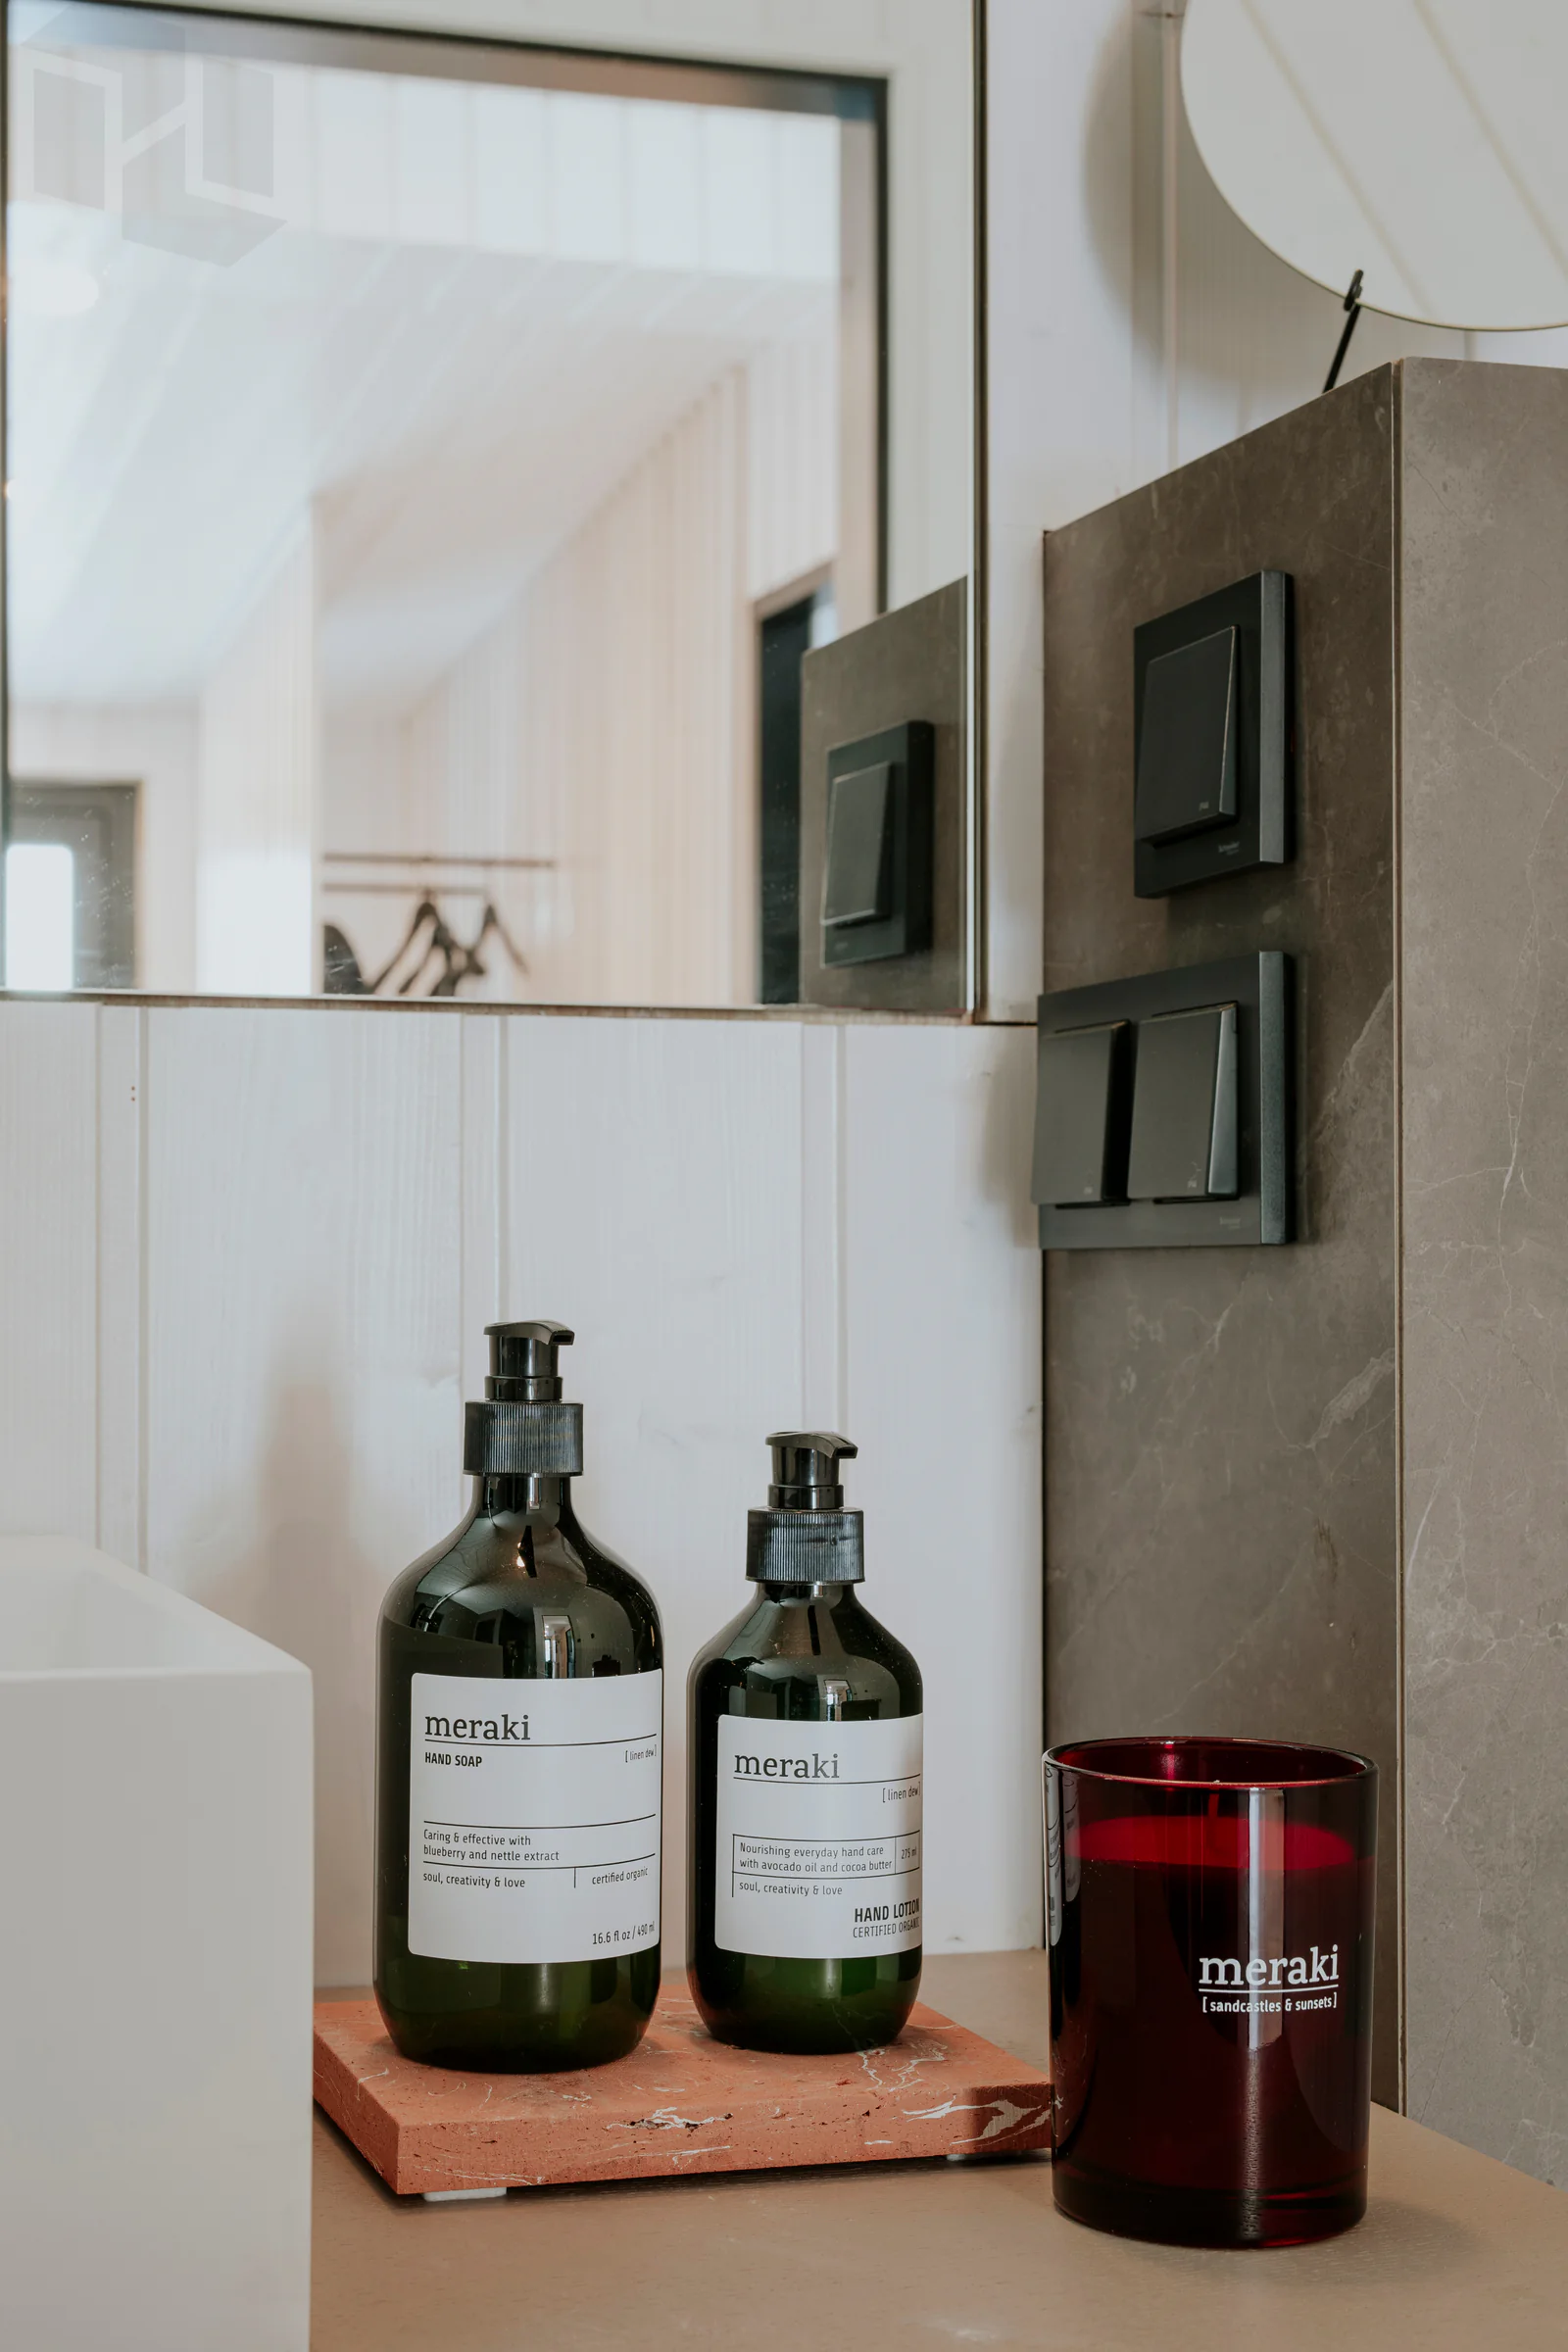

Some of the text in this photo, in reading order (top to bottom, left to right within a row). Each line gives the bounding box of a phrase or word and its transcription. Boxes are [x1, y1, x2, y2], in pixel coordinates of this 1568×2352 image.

[425, 1714, 531, 1740] meraki
[424, 1752, 482, 1767] HAND SOAP
[734, 1753, 840, 1779] meraki
[887, 1788, 906, 1801] linen
[423, 1829, 531, 1845] Caring & effective with
[423, 1844, 560, 1861] blueberry and nettle extract
[740, 1842, 884, 1859] Nourishing everyday hand care
[901, 1847, 911, 1860] 275
[740, 1859, 892, 1873] with avocado oil and cocoa butter
[423, 1873, 526, 1888] soul, creativity & love
[591, 1866, 648, 1885] certified organic
[739, 1882, 843, 1896] soul, creativity & love
[855, 1897, 920, 1923] HAND LOTION
[853, 1916, 920, 1937] CERTIFIED ORGANIC
[592, 1931, 612, 1945] 16.6
[613, 1931, 619, 1942] fl
[621, 1931, 630, 1940] oz
[1199, 1944, 1339, 1985] meraki
[1209, 1999, 1282, 2012] sandcastles
[1285, 1998, 1293, 2011] &
